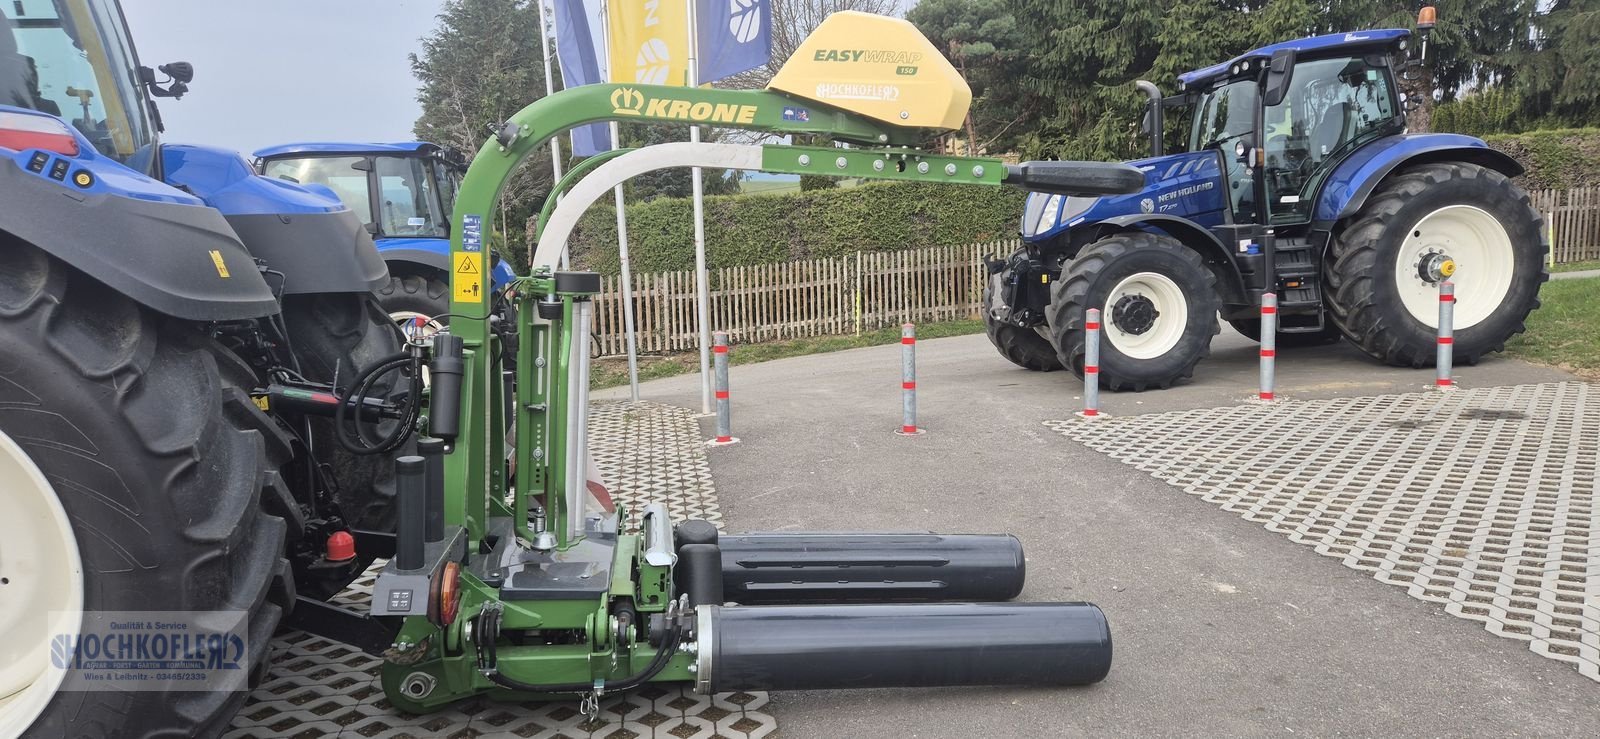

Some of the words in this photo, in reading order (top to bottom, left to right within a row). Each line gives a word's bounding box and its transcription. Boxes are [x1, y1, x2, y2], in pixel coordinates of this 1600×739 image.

[813, 49, 922, 64] EASYWRAP
[900, 67, 914, 75] 150
[644, 98, 758, 124] KRONE
[1158, 191, 1177, 203] NEW
[1177, 181, 1214, 197] HOLLAND
